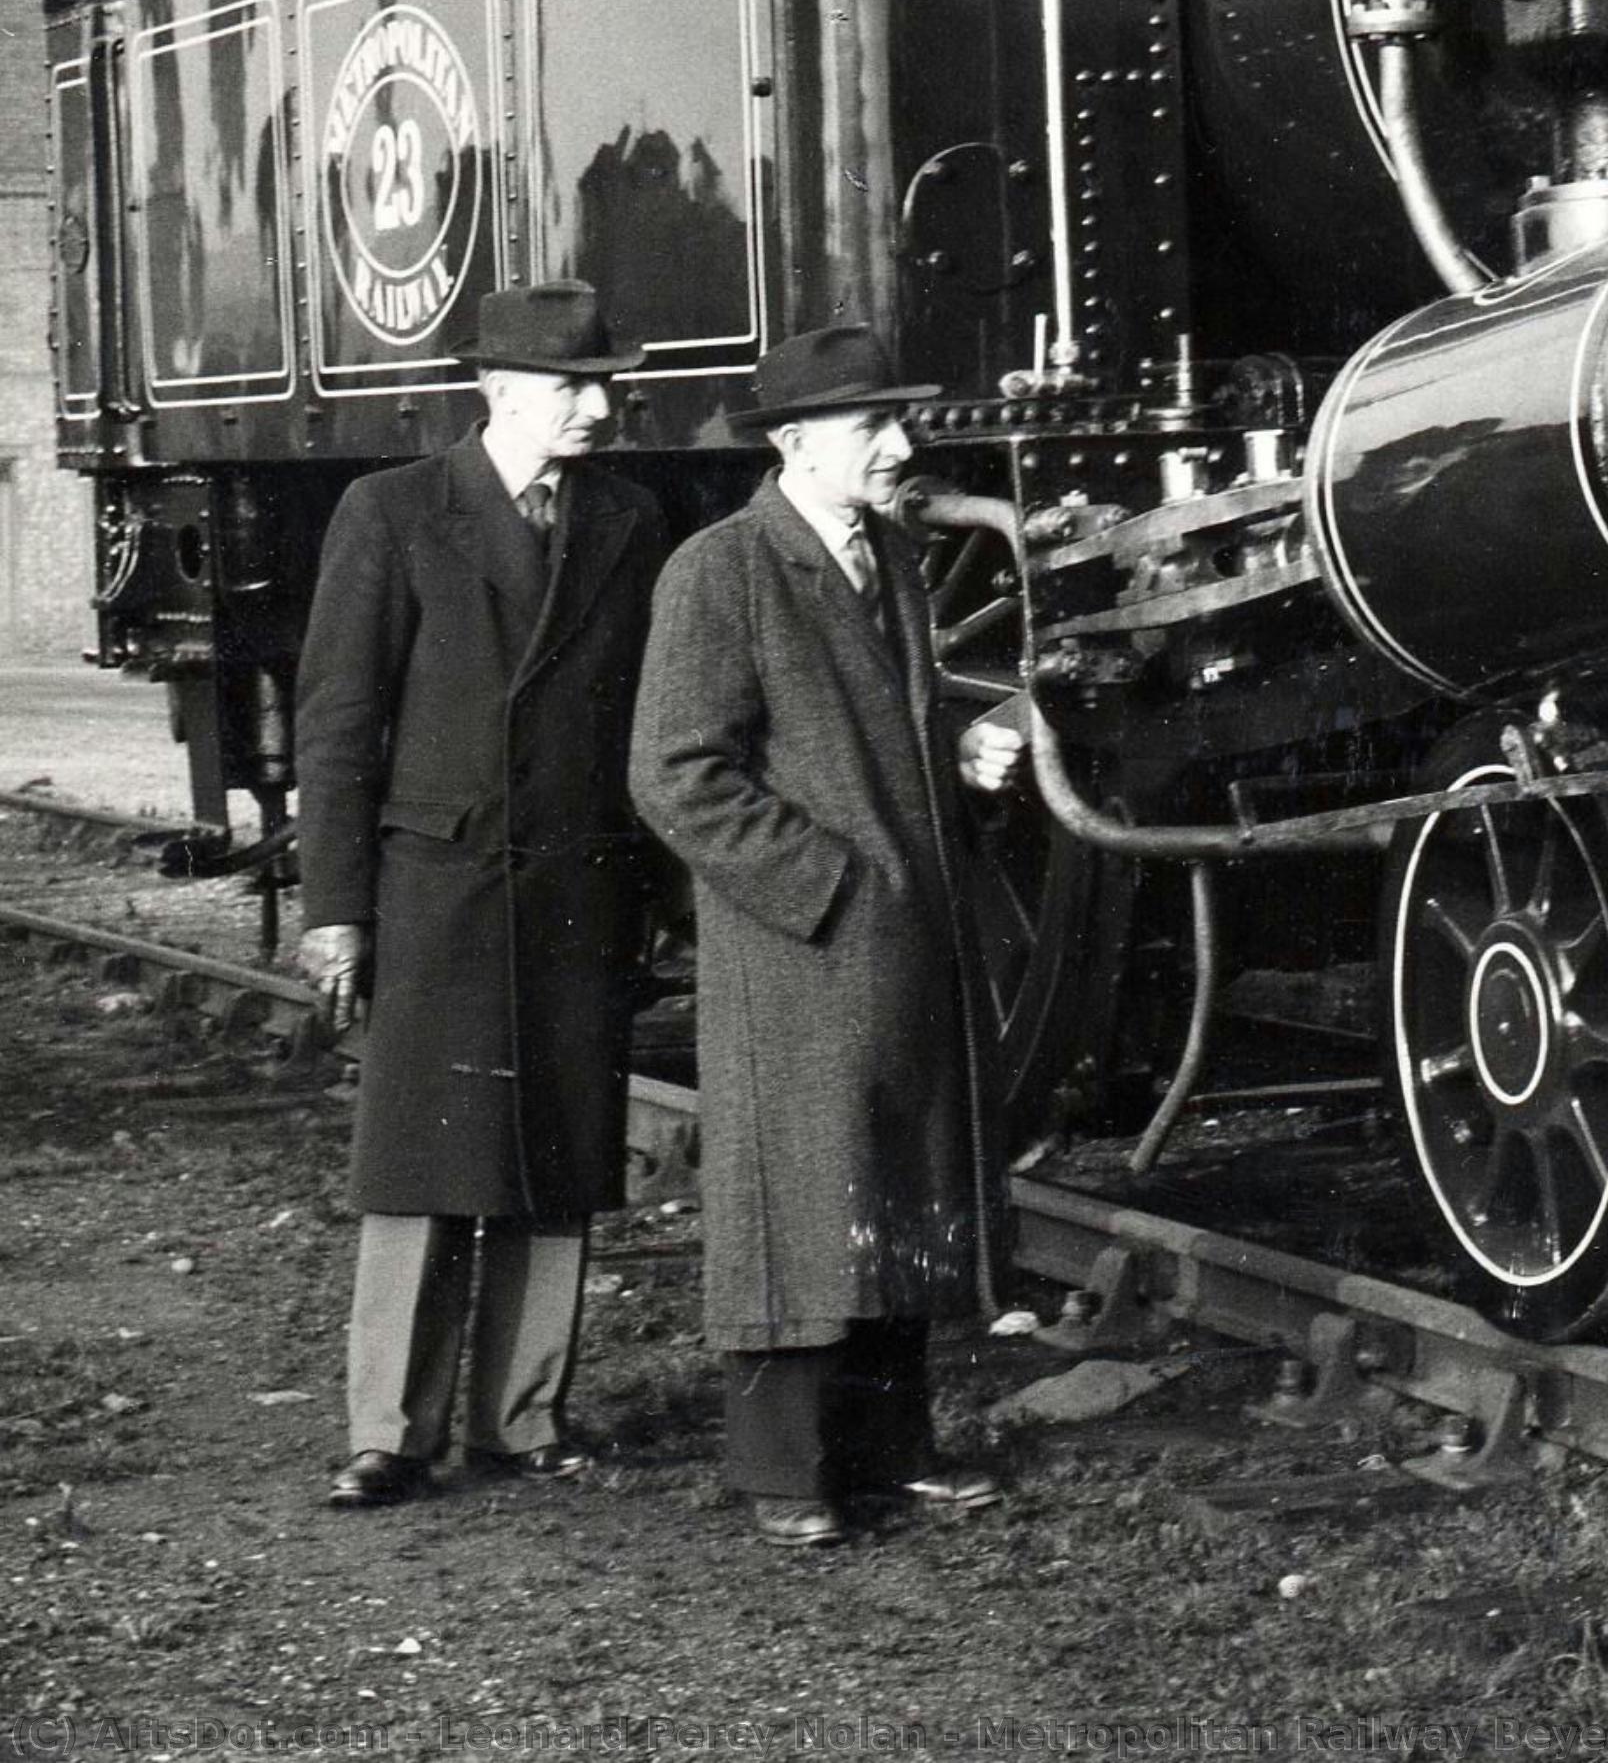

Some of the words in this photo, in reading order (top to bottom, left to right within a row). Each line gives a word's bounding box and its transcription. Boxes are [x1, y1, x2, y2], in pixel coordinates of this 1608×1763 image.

[325, 18, 475, 156] METROPOLITAN
[371, 118, 425, 232] 23
[352, 243, 456, 331] RAILWAY
